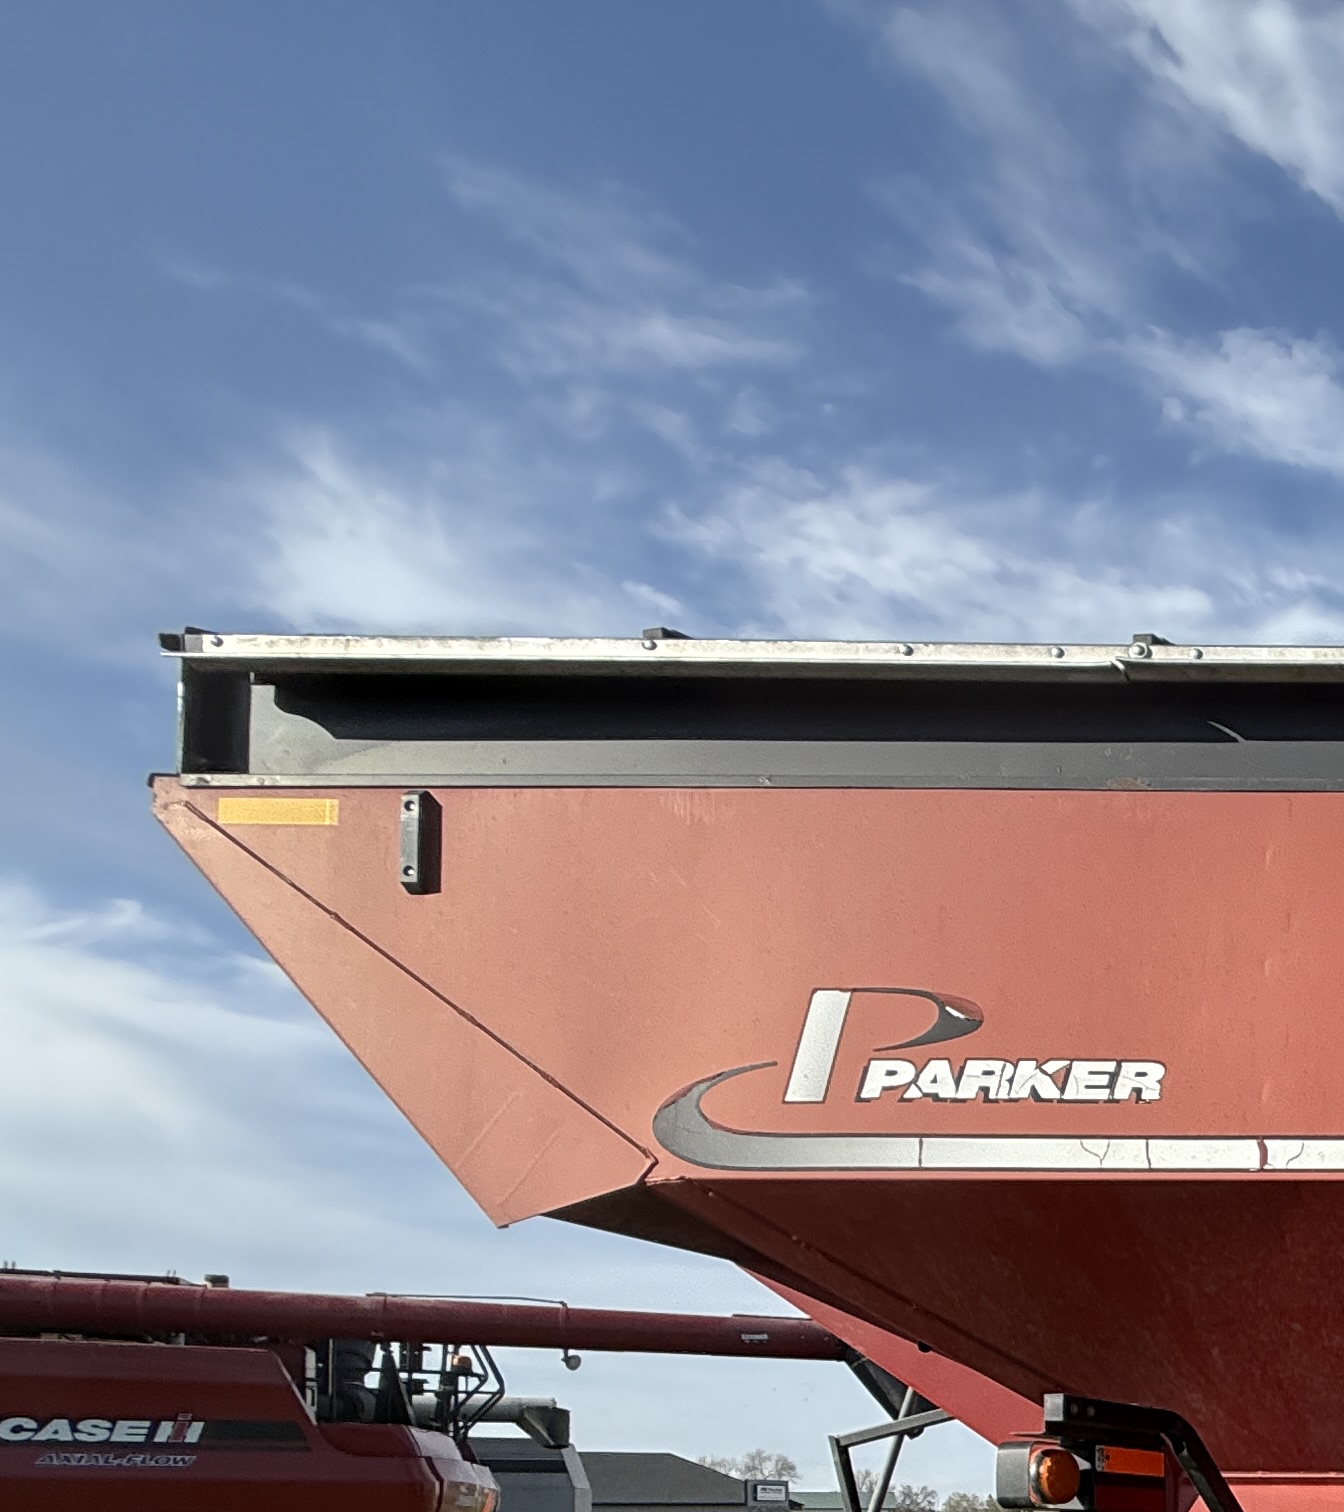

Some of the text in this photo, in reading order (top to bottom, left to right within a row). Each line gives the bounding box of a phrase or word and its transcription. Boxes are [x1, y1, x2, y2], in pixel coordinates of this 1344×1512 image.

[856, 1057, 1167, 1104] PARKER
[0, 1416, 151, 1442] CASE
[35, 1451, 197, 1467] AXIAL-FLOW
